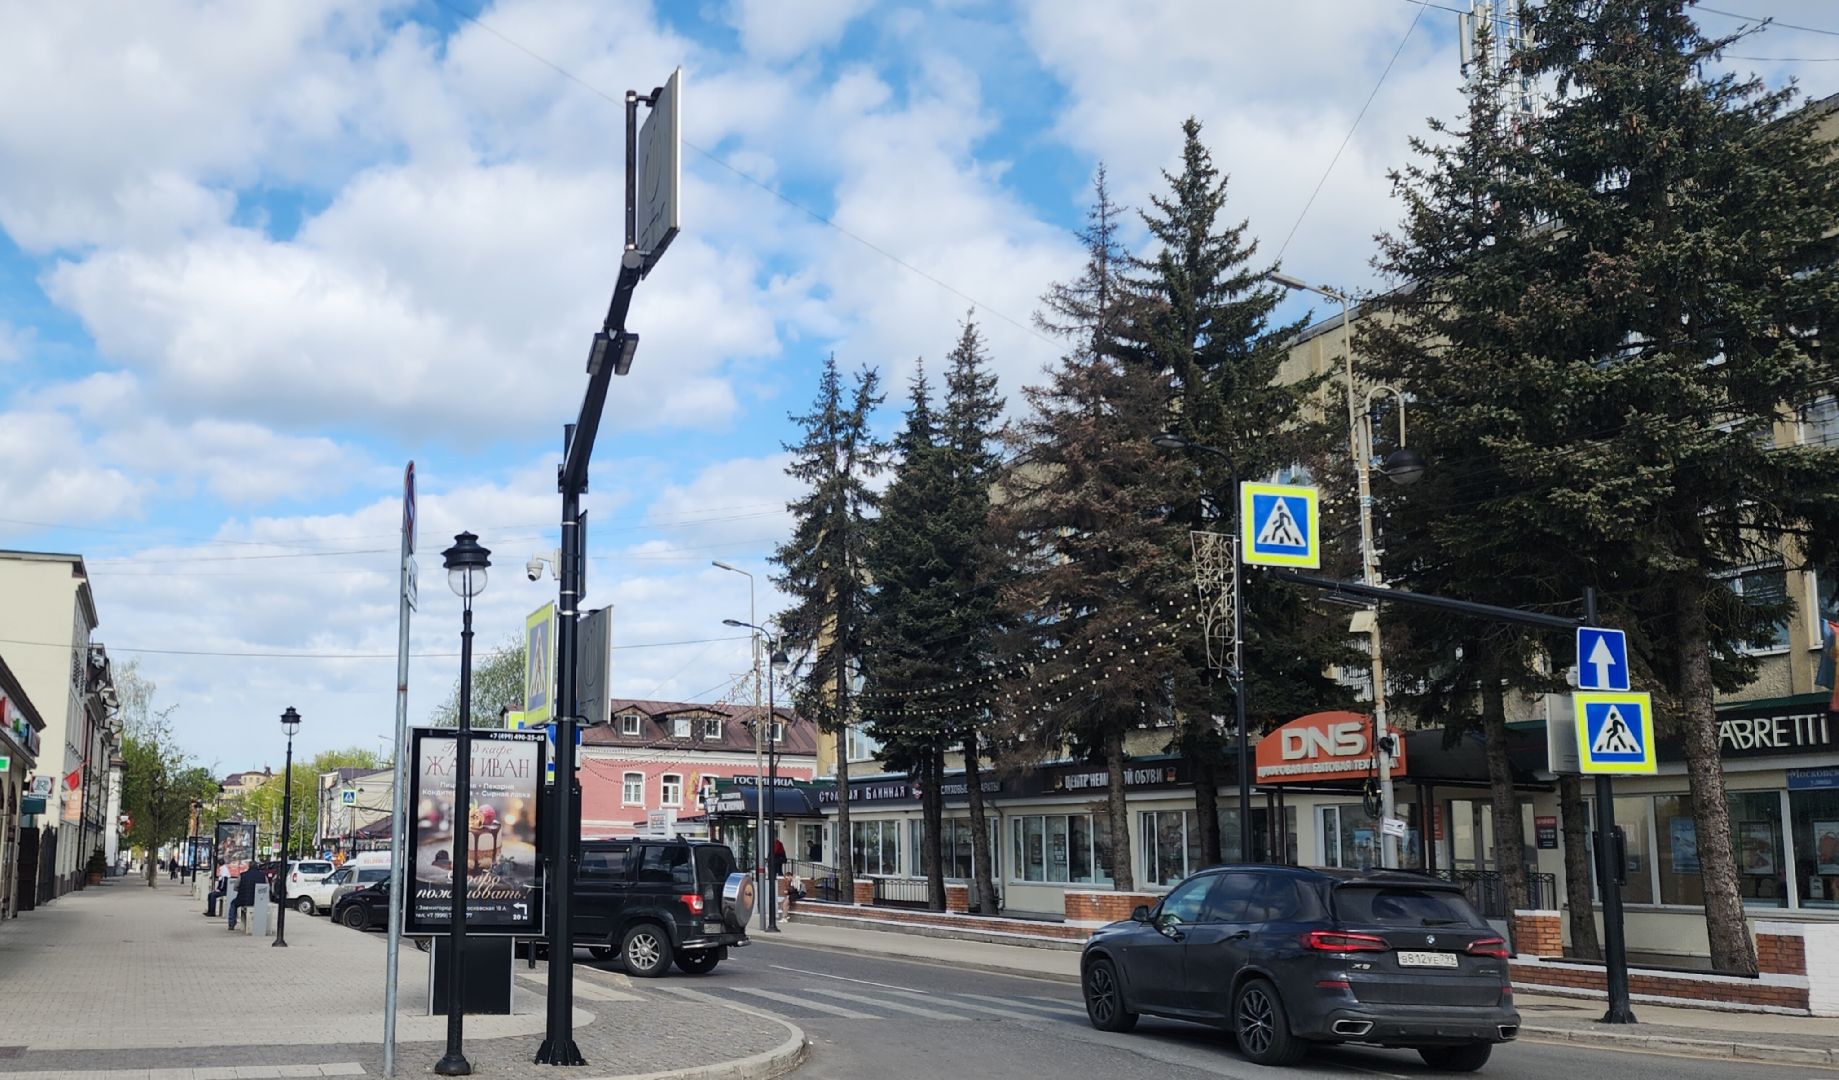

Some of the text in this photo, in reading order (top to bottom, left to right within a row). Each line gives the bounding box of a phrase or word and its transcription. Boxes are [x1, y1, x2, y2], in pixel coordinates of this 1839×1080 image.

[1282, 721, 1366, 760] DNS
[1715, 713, 1829, 750] ABRETTi
[442, 741, 480, 757] Грд
[480, 757, 530, 778] ИВАН
[1090, 768, 1134, 787] НЕМОЙ
[1135, 768, 1163, 784] ОБУВИ
[818, 788, 858, 803] СТОЛАЯ
[416, 883, 531, 900] пожловать!
